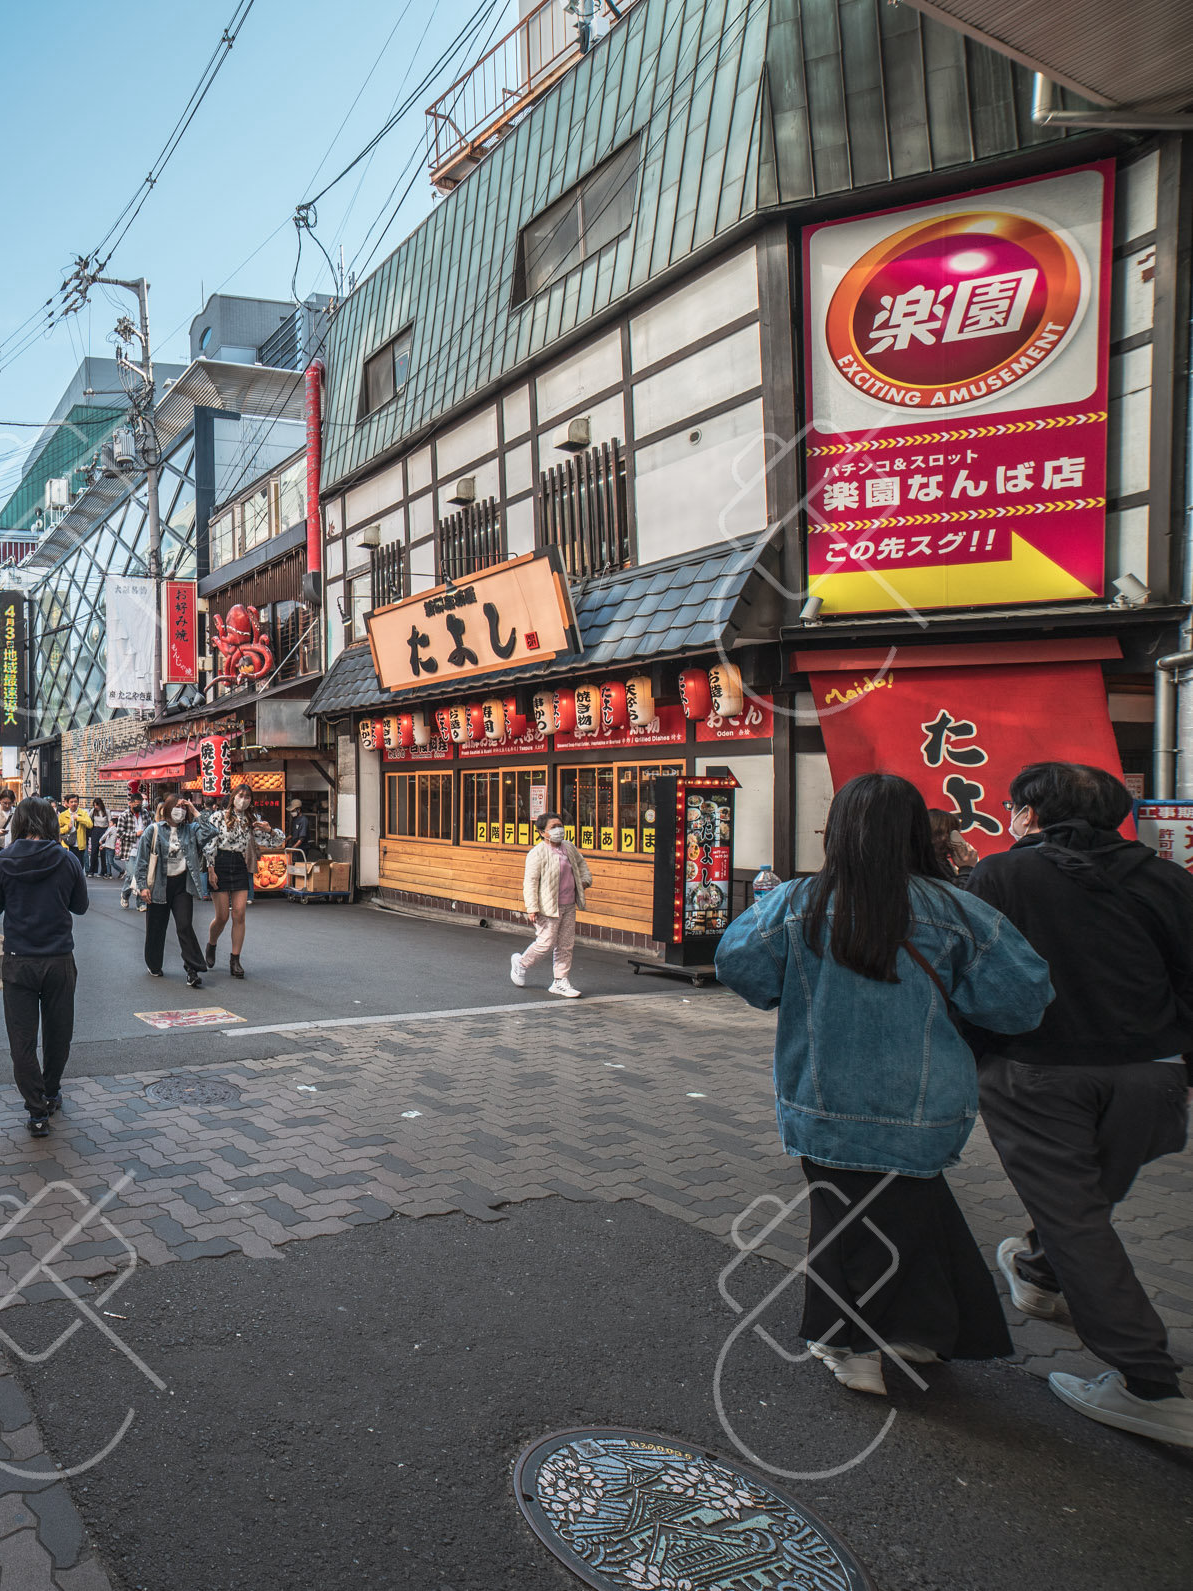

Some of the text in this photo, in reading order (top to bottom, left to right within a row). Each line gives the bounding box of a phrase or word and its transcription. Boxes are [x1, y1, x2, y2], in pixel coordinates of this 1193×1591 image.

[864, 268, 1039, 355] 楽園
[837, 321, 1065, 407] EXCITING AMUSEMENT
[823, 449, 979, 479] パチンコ&スロット
[823, 457, 1086, 512] 楽園なんば店
[175, 589, 189, 642] お好み焼
[407, 602, 517, 677] たよし
[600, 686, 614, 725] たよし
[625, 683, 639, 721] 天ぷら
[709, 671, 723, 711] お造り
[825, 672, 894, 704] Maido!
[436, 711, 449, 742] たよし
[534, 698, 547, 731] 串かつ
[577, 690, 592, 727] 焼き物
[361, 722, 372, 748] 串かつ
[201, 741, 216, 794] 焼そば
[921, 709, 1003, 836] たよ
[701, 822, 714, 889] たよし
